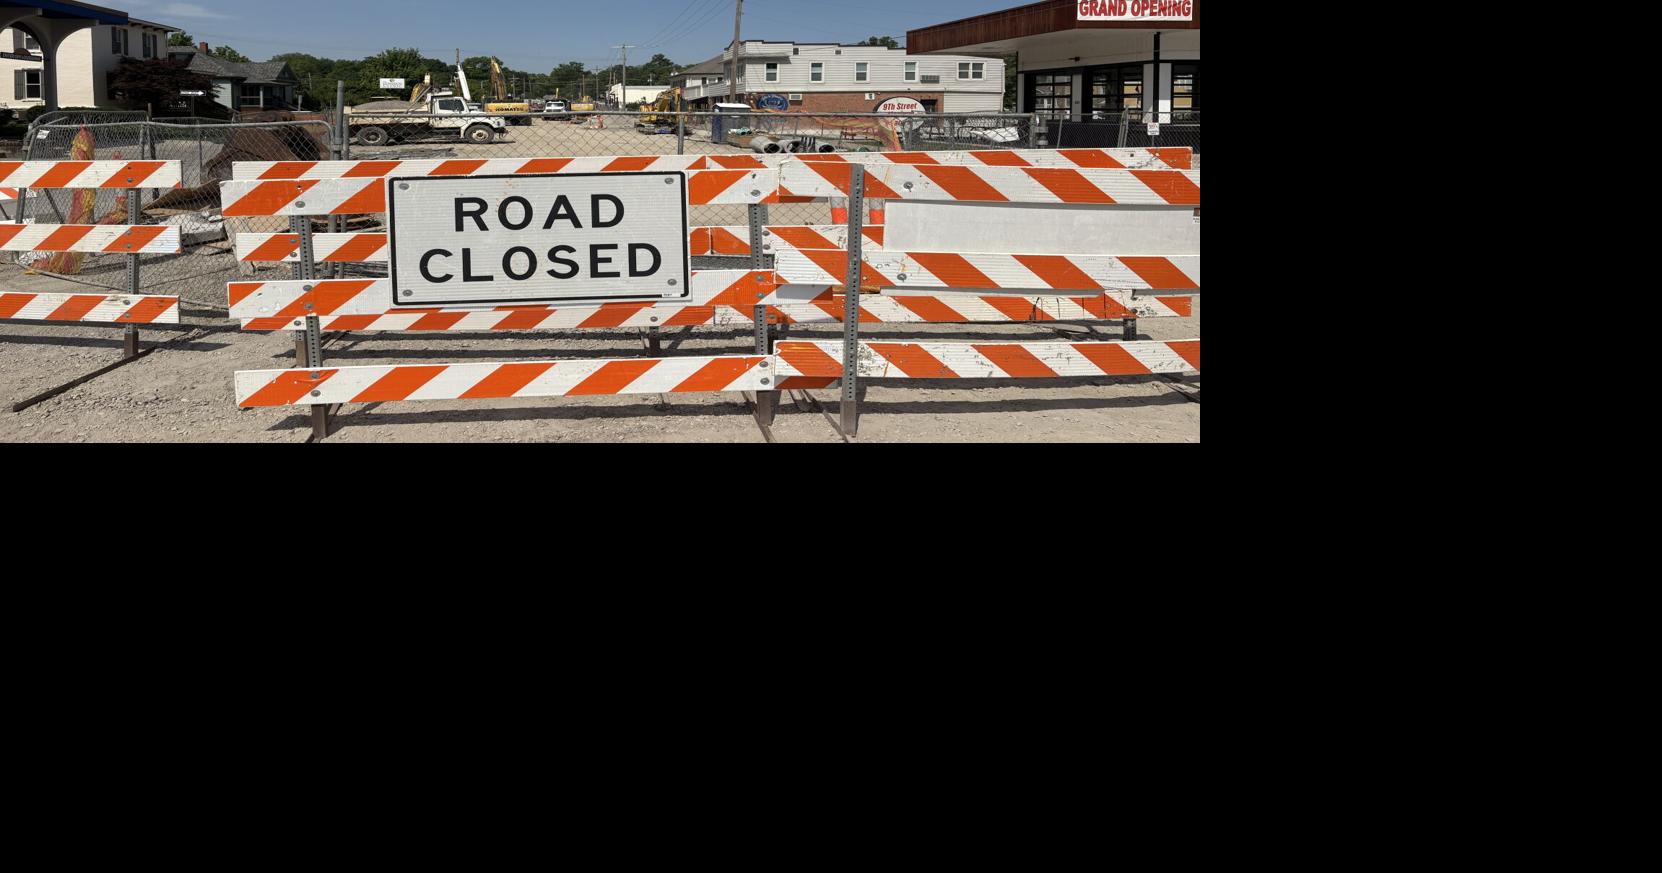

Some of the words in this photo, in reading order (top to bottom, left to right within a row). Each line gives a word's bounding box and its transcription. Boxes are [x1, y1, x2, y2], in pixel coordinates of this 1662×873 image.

[1079, 0, 1127, 16] GRAND
[1131, 0, 1191, 16] OPENING
[454, 194, 625, 232] ROAD
[419, 243, 662, 283] CLOSED
